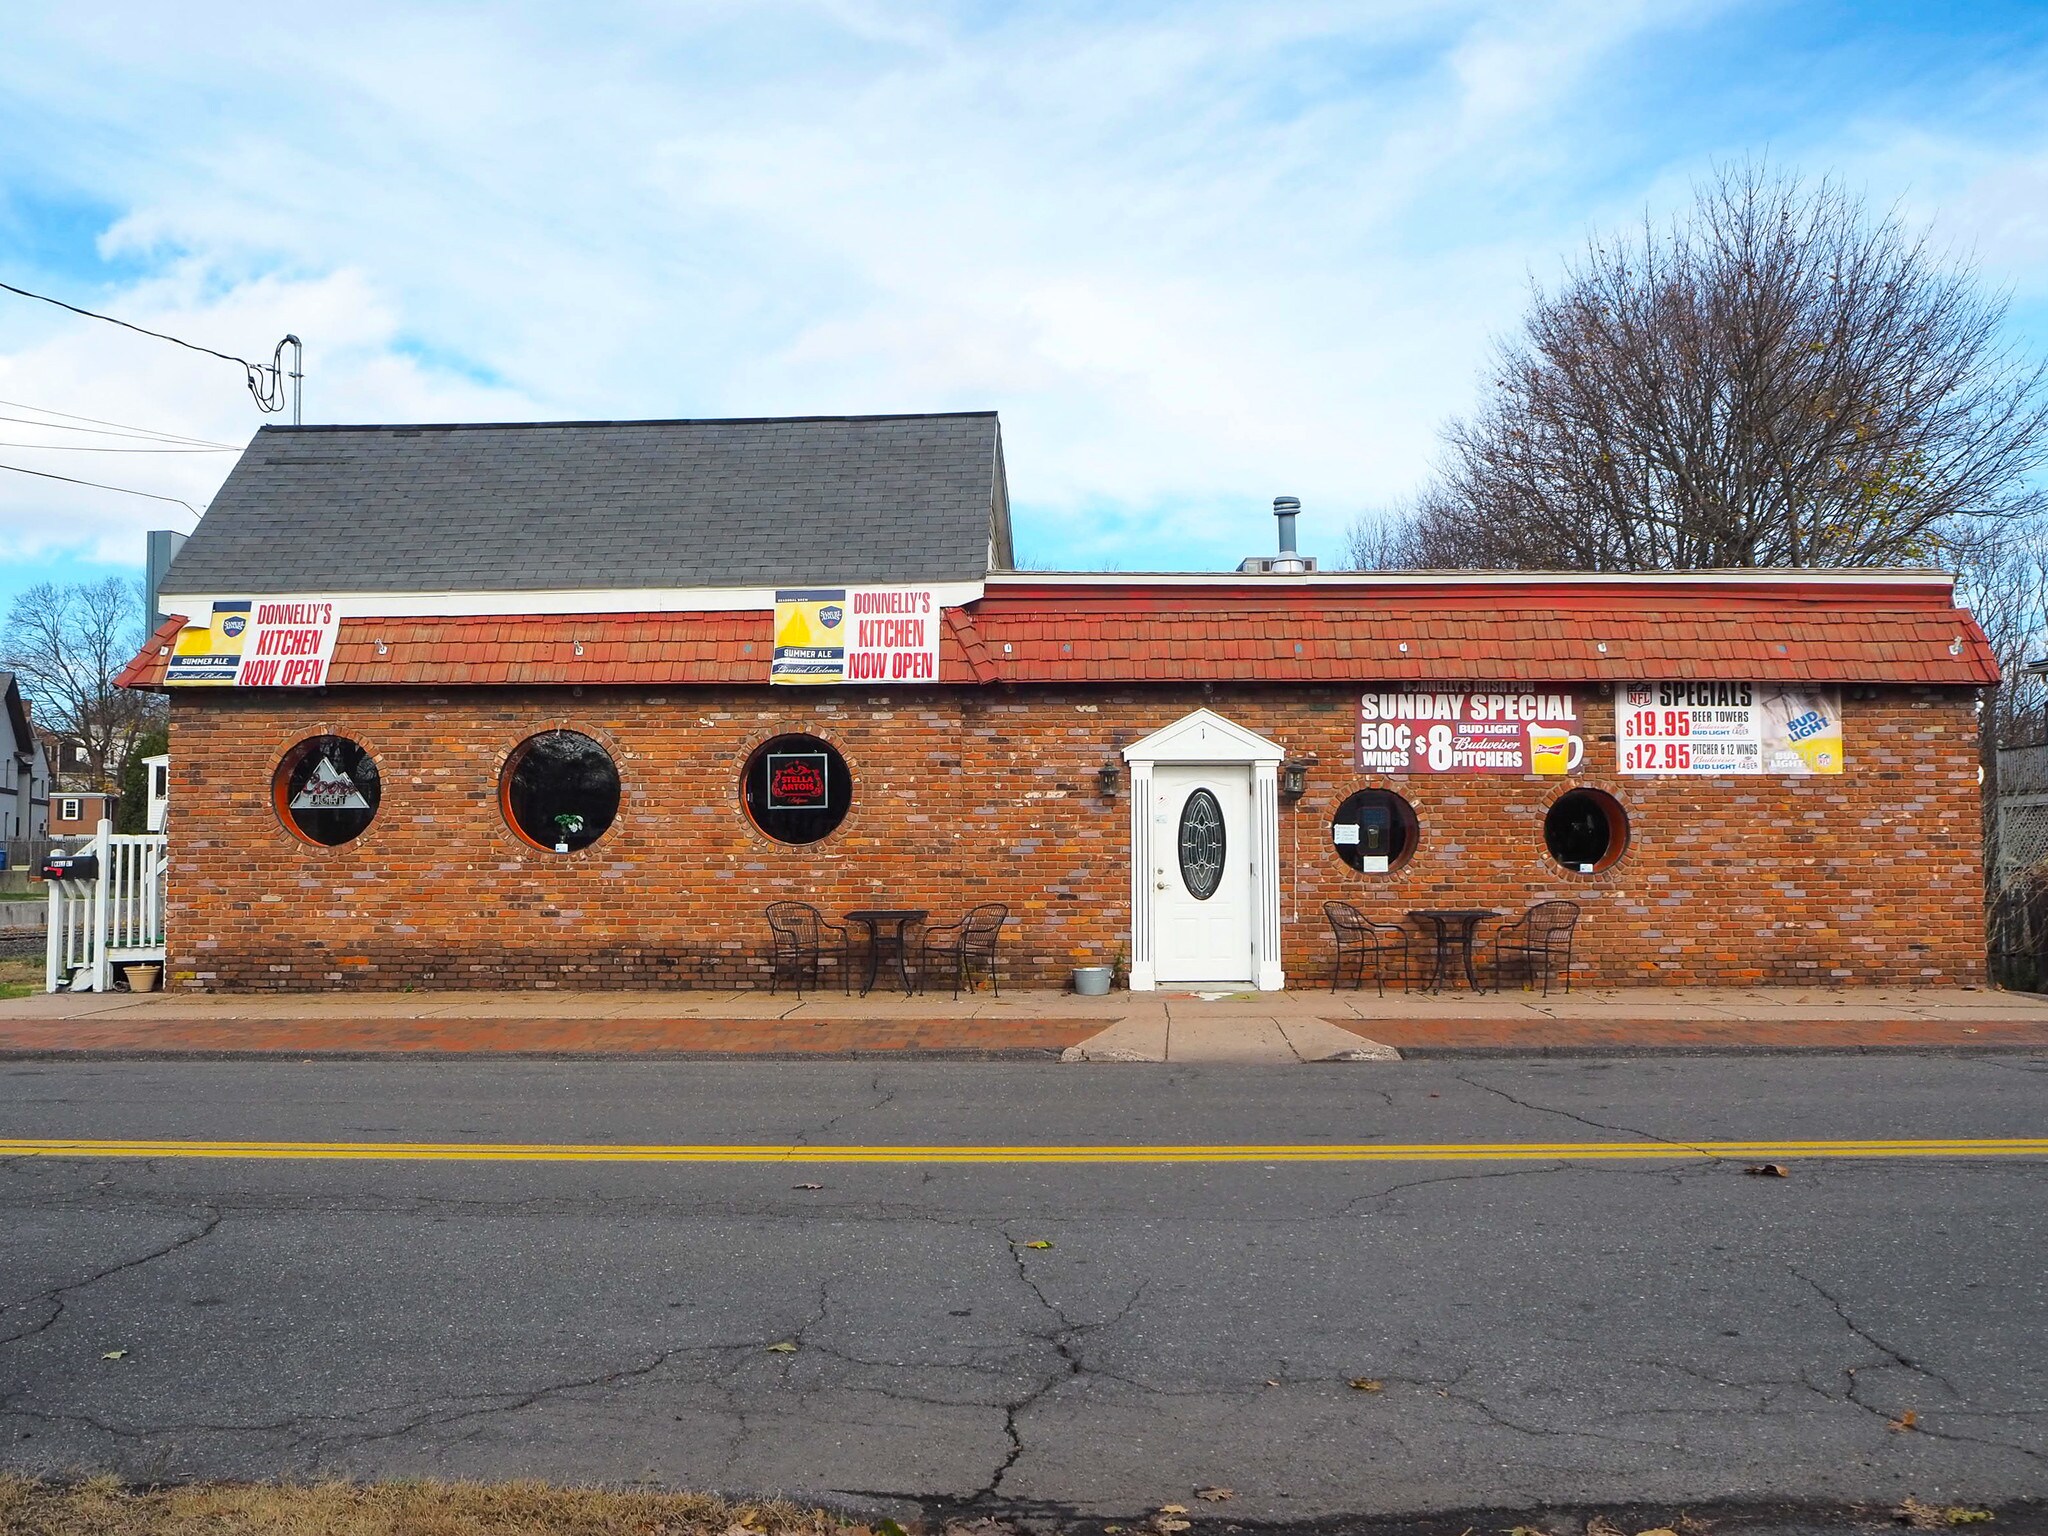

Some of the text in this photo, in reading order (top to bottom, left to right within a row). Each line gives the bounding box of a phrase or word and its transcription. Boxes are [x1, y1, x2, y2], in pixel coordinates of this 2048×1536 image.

[257, 603, 332, 624] DONNELLY'S
[854, 592, 930, 614] DONNELLY'S
[256, 630, 323, 656] KITCHEN
[858, 619, 924, 647] KITCHEN
[784, 649, 816, 657] SUMMER
[239, 659, 324, 686] NOW OPEN
[848, 652, 933, 679] NOW OPEN
[1474, 681, 1507, 692] IRISH
[1510, 681, 1535, 692] PUB
[1659, 682, 1752, 707] SPECIALS
[1361, 694, 1576, 721] SUNDAY SPECIAL
[1630, 693, 1650, 704] NFL
[1626, 711, 1690, 737] $19.95
[1692, 711, 1749, 722] BEER TOWERS
[1787, 711, 1818, 731] BUD
[1361, 723, 1411, 751] 50¢
[1459, 725, 1519, 734] BUD LIGHT
[1788, 717, 1830, 742] LIGHT
[1415, 725, 1452, 770] $8
[1452, 737, 1520, 750] Budweiser
[1692, 744, 1758, 755] PITCHER & 12 WINGS
[1362, 751, 1409, 767] WINGS
[1452, 751, 1522, 767] PITCHERS
[1626, 744, 1690, 769] $12.95
